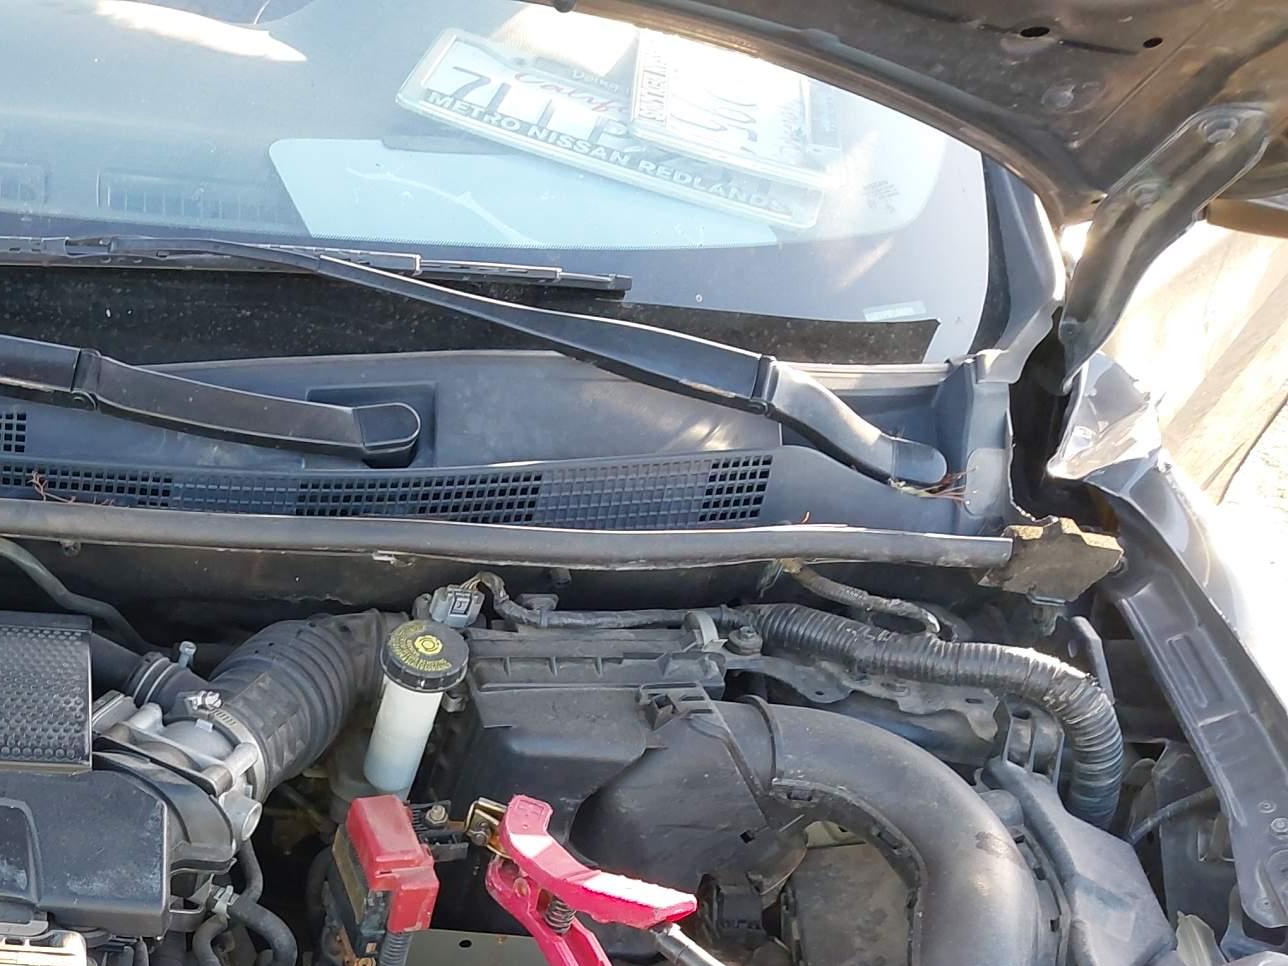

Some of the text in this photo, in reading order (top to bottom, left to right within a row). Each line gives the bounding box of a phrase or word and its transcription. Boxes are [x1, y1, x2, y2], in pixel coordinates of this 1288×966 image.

[429, 91, 521, 131] METRO
[528, 125, 630, 165] NISSAN
[638, 160, 786, 211] REDLANDS
